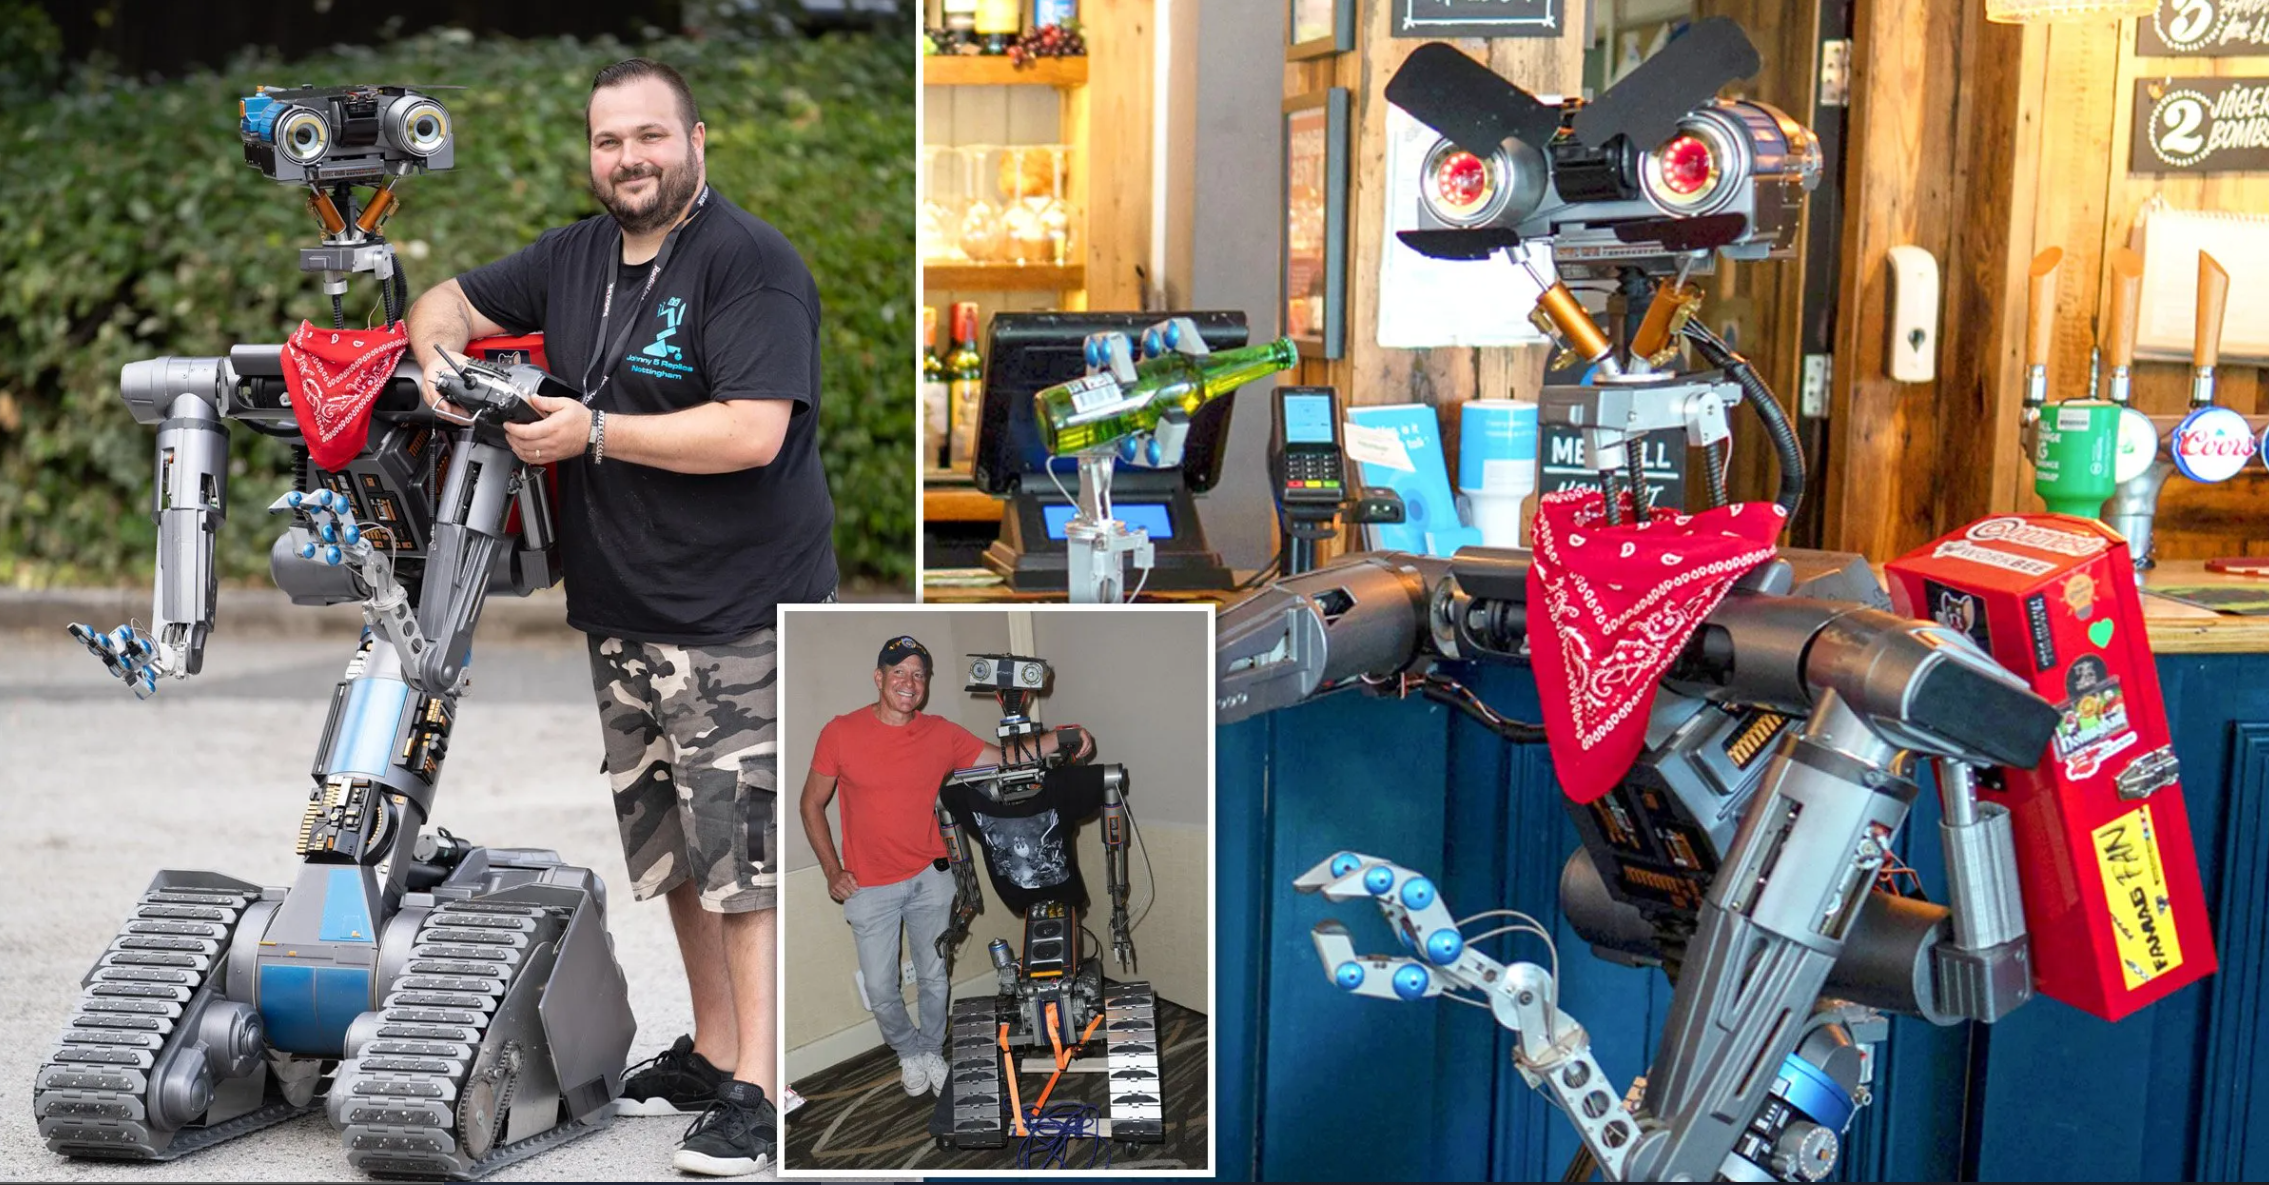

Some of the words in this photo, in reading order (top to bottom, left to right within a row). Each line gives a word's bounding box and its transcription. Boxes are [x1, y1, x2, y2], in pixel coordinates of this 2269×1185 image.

[2160, 99, 2203, 154] 2
[631, 364, 682, 380] Nottingham
[2180, 430, 2255, 457] Coors
